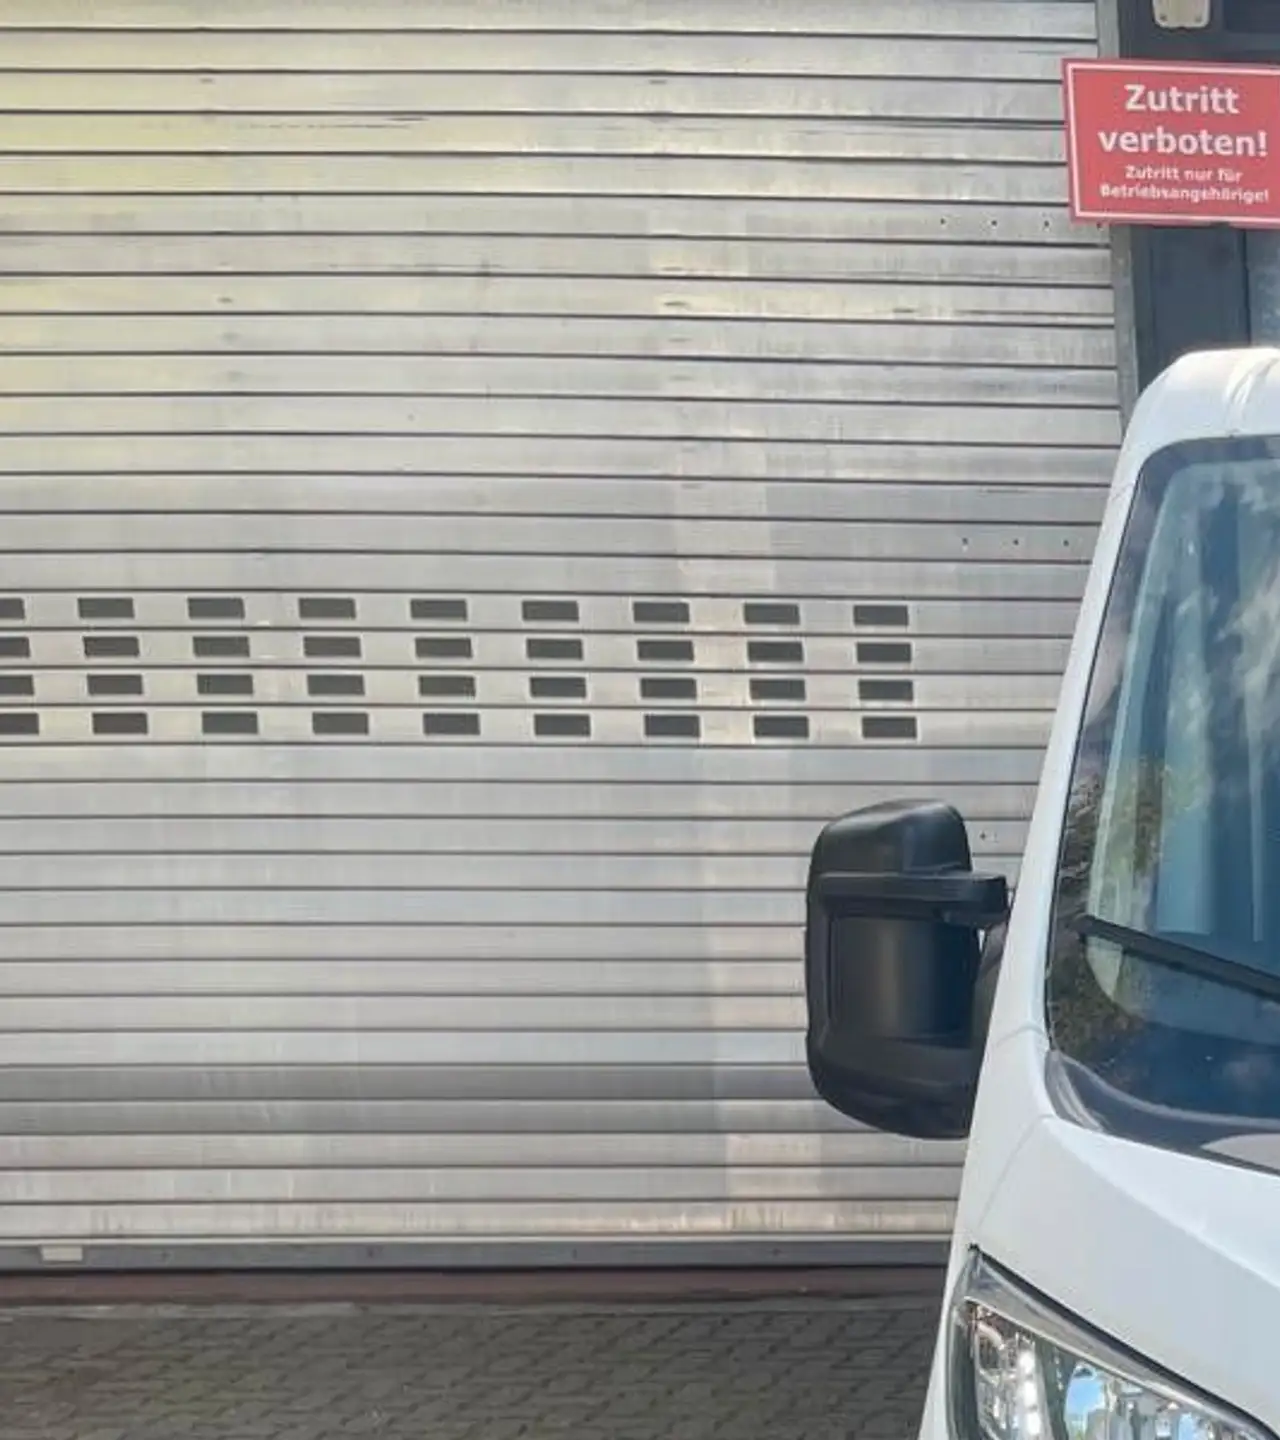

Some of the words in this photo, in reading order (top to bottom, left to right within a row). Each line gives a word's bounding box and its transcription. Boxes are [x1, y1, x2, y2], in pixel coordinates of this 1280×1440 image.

[1123, 84, 1240, 114] Zutritt
[1097, 126, 1269, 157] verboten!
[1125, 165, 1180, 181] Zutritt
[1184, 168, 1213, 181] nur
[1217, 167, 1243, 182] für
